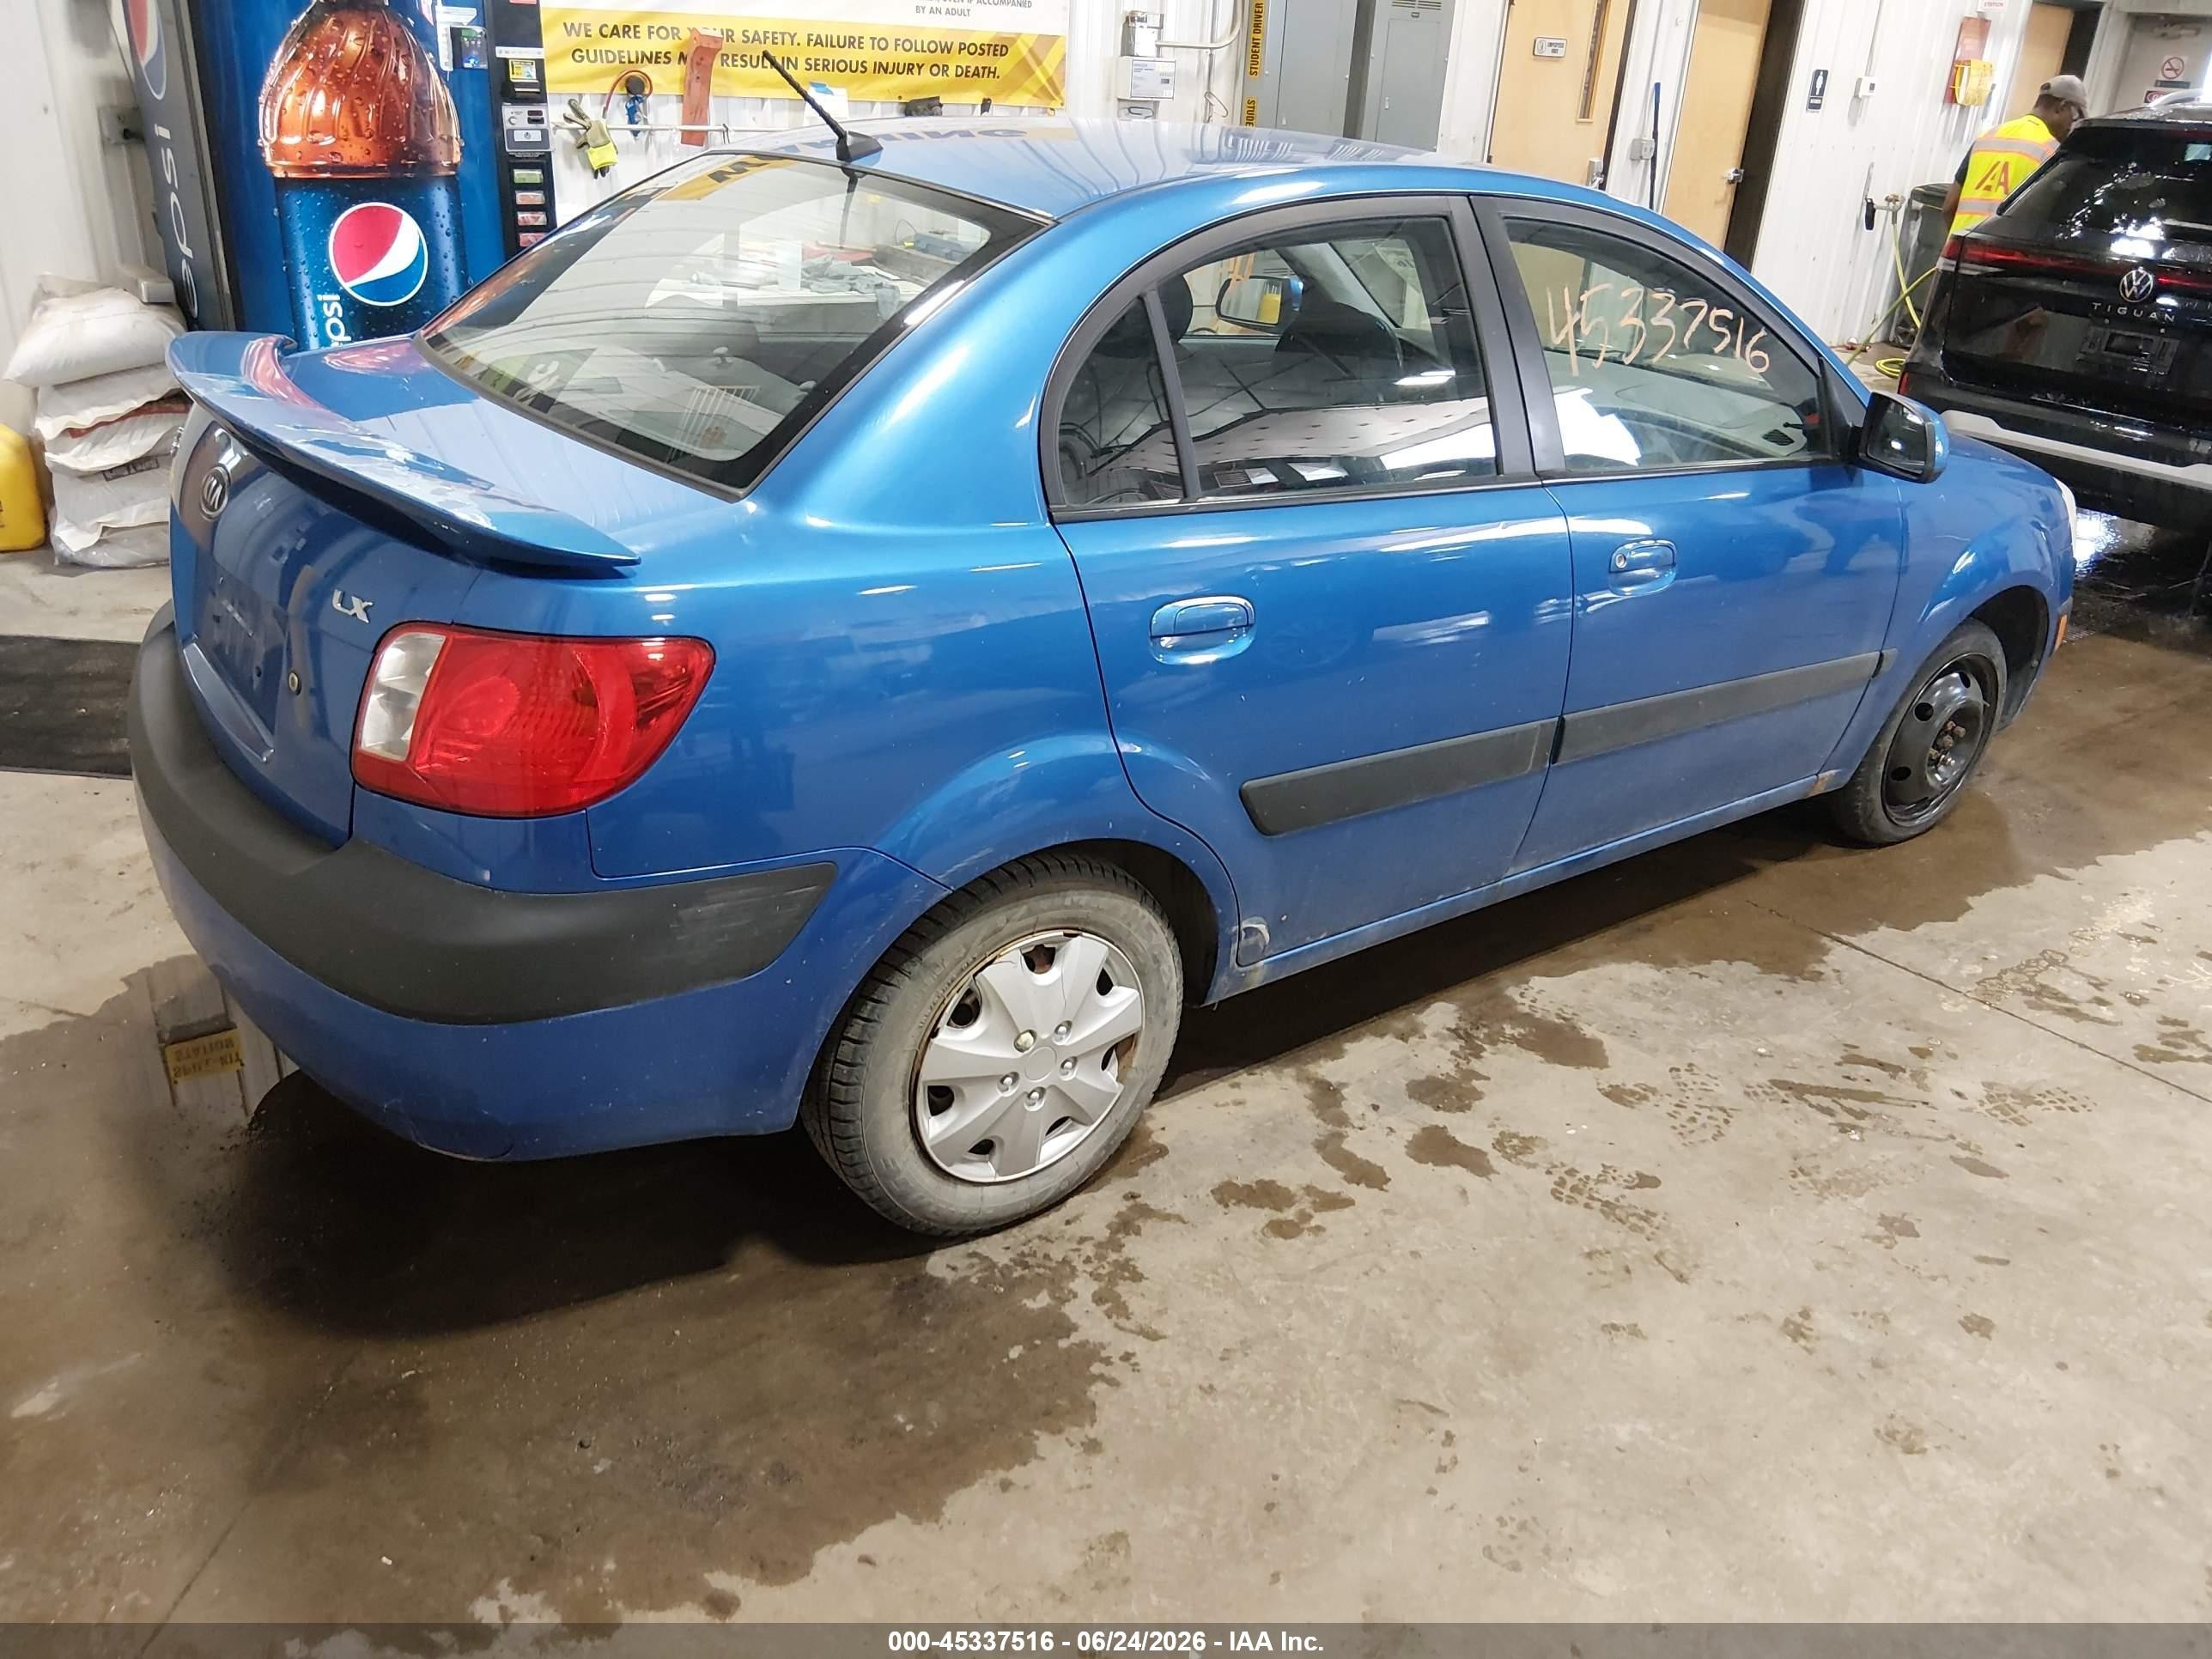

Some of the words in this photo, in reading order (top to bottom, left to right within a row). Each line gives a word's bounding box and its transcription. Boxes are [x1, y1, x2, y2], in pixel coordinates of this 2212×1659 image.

[915, 5, 926, 14] BY
[945, 8, 970, 17] ADULT
[1253, 3, 1264, 34] DRIVER
[563, 21, 592, 38] WE
[599, 23, 641, 40] CARE
[647, 25, 682, 40] FOR
[742, 29, 800, 46] SAFETY.
[806, 33, 864, 50] FAILURE
[870, 36, 889, 52] TO
[894, 38, 954, 54] FOLLOW
[957, 42, 1008, 58] POSTED
[1249, 37, 1261, 76] STUDENT
[571, 49, 672, 65] GUIDELINES
[780, 56, 799, 70] IN
[805, 58, 867, 74] SERIOUS
[872, 62, 924, 76] INJURY
[929, 64, 950, 78] OR
[955, 64, 1000, 80] DEATH.
[154, 123, 198, 330] epsi
[1547, 283, 1770, 377] 45337516
[2092, 302, 2176, 323] TIGUAN
[332, 588, 374, 624] LX
